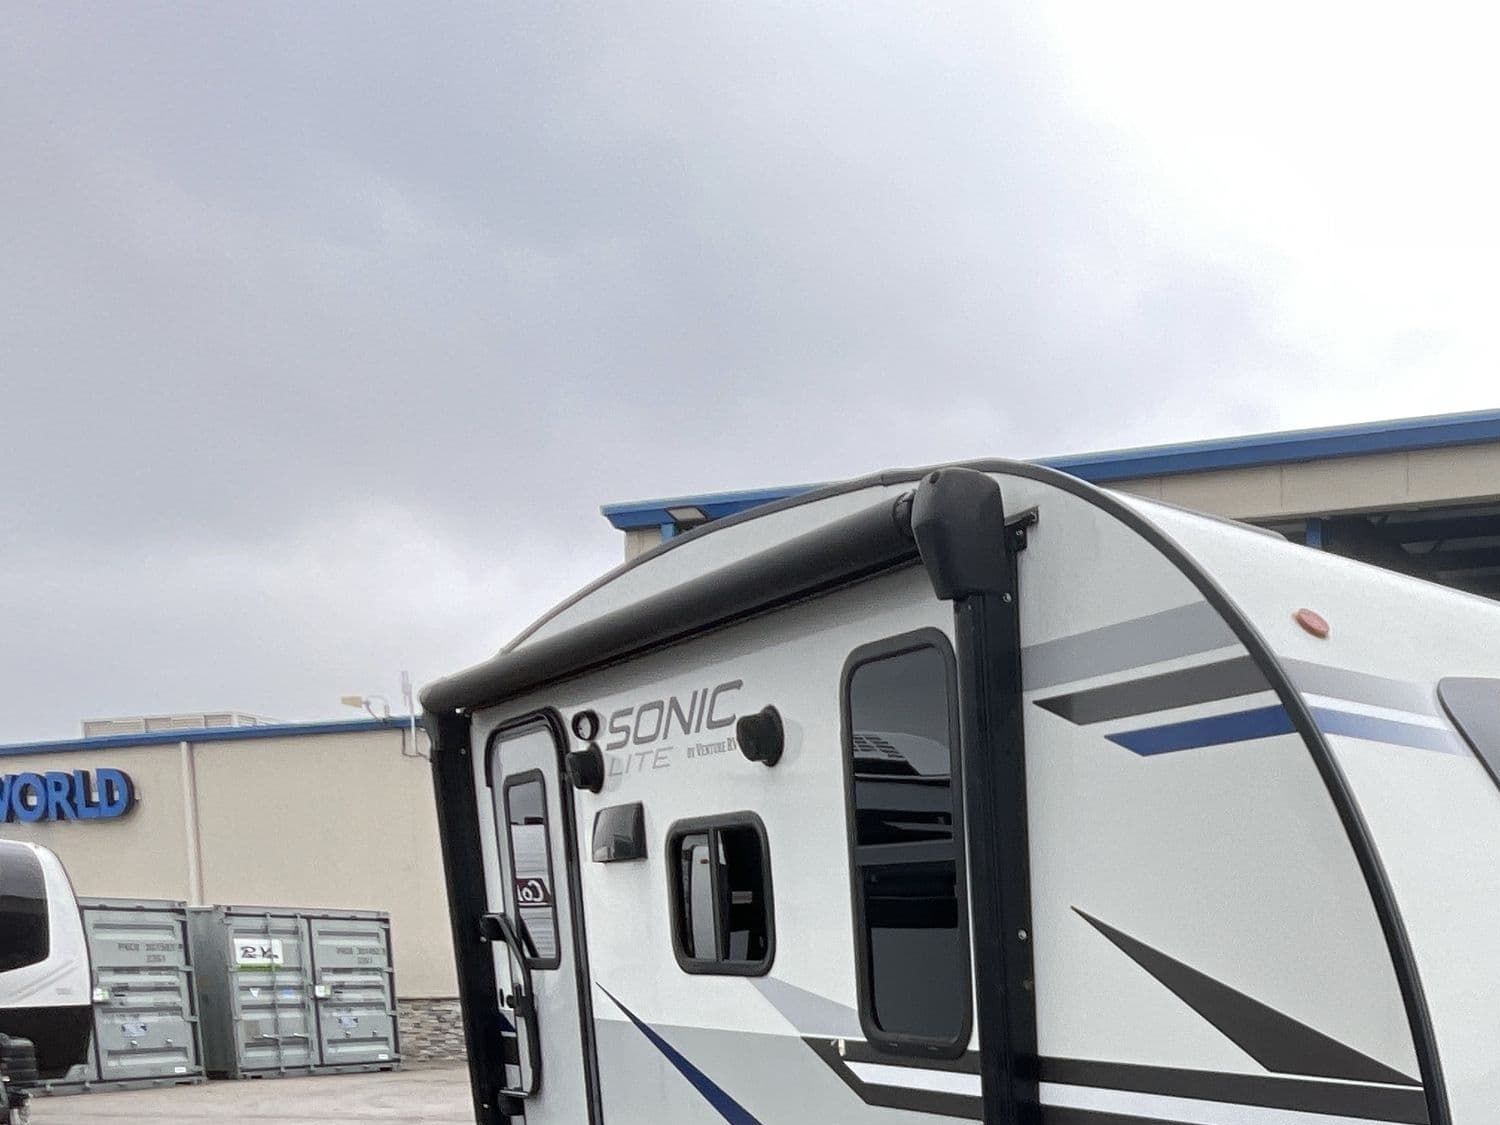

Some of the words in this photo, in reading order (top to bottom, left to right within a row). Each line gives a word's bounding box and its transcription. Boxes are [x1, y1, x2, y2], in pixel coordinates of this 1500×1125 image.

[605, 679, 744, 751] SONIC
[608, 746, 674, 777] LITE
[0, 767, 135, 823] ORLD
